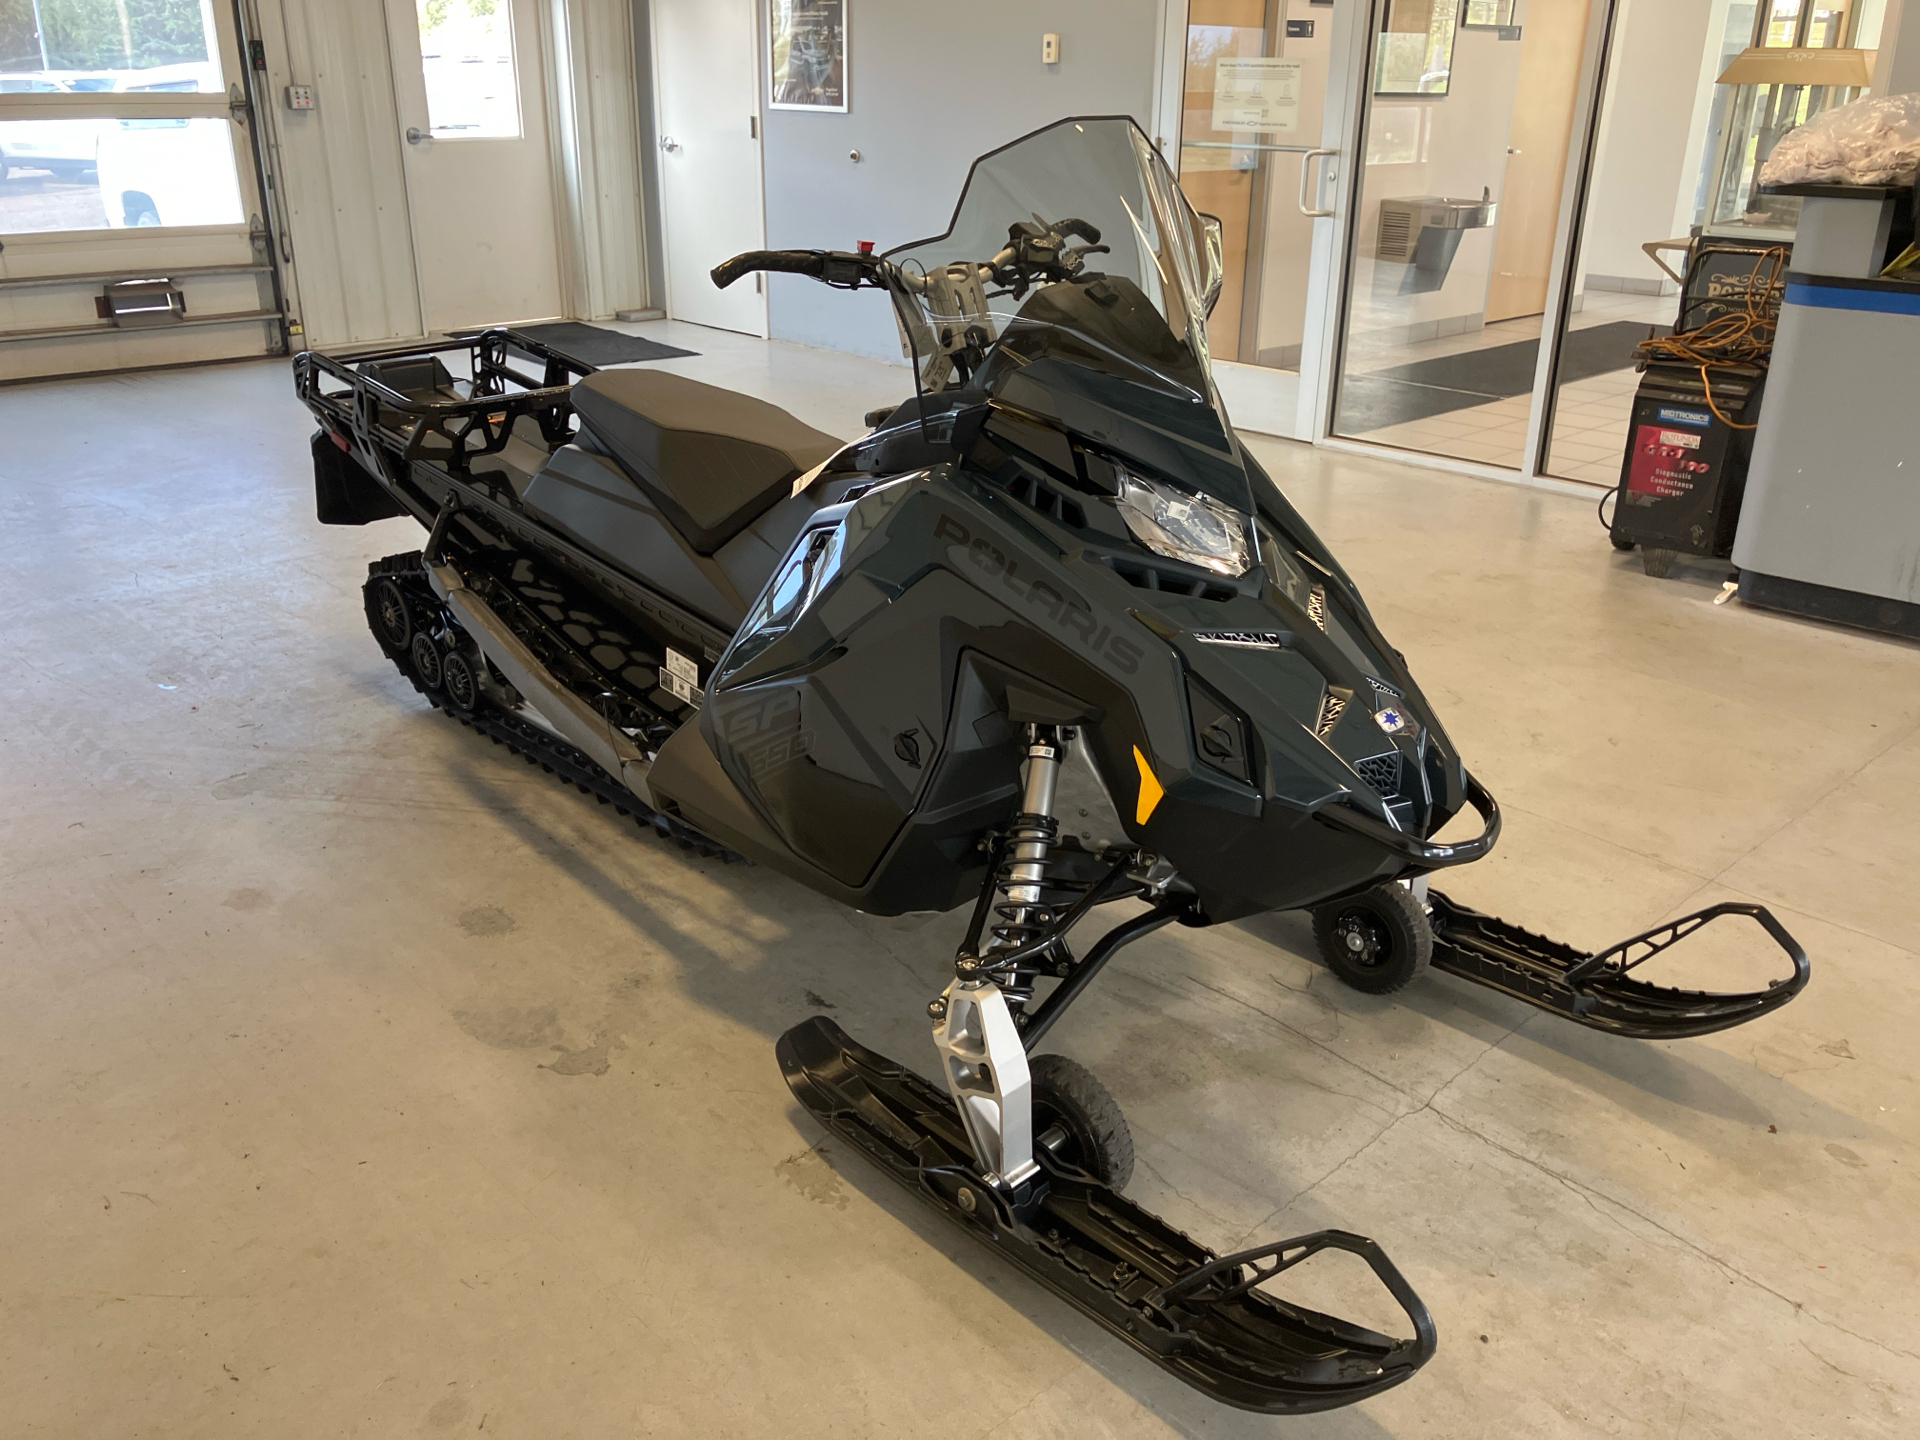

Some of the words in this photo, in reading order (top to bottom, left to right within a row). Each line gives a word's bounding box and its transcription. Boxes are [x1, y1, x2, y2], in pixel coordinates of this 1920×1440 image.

[1660, 408, 1710, 423] MIDTRONICS
[1661, 431, 1700, 444] ROTUNDA
[1655, 467, 1692, 480] Diagnostic
[1649, 475, 1694, 489] Conductance
[1656, 485, 1685, 497] Charger
[933, 513, 1146, 675] POLARIS
